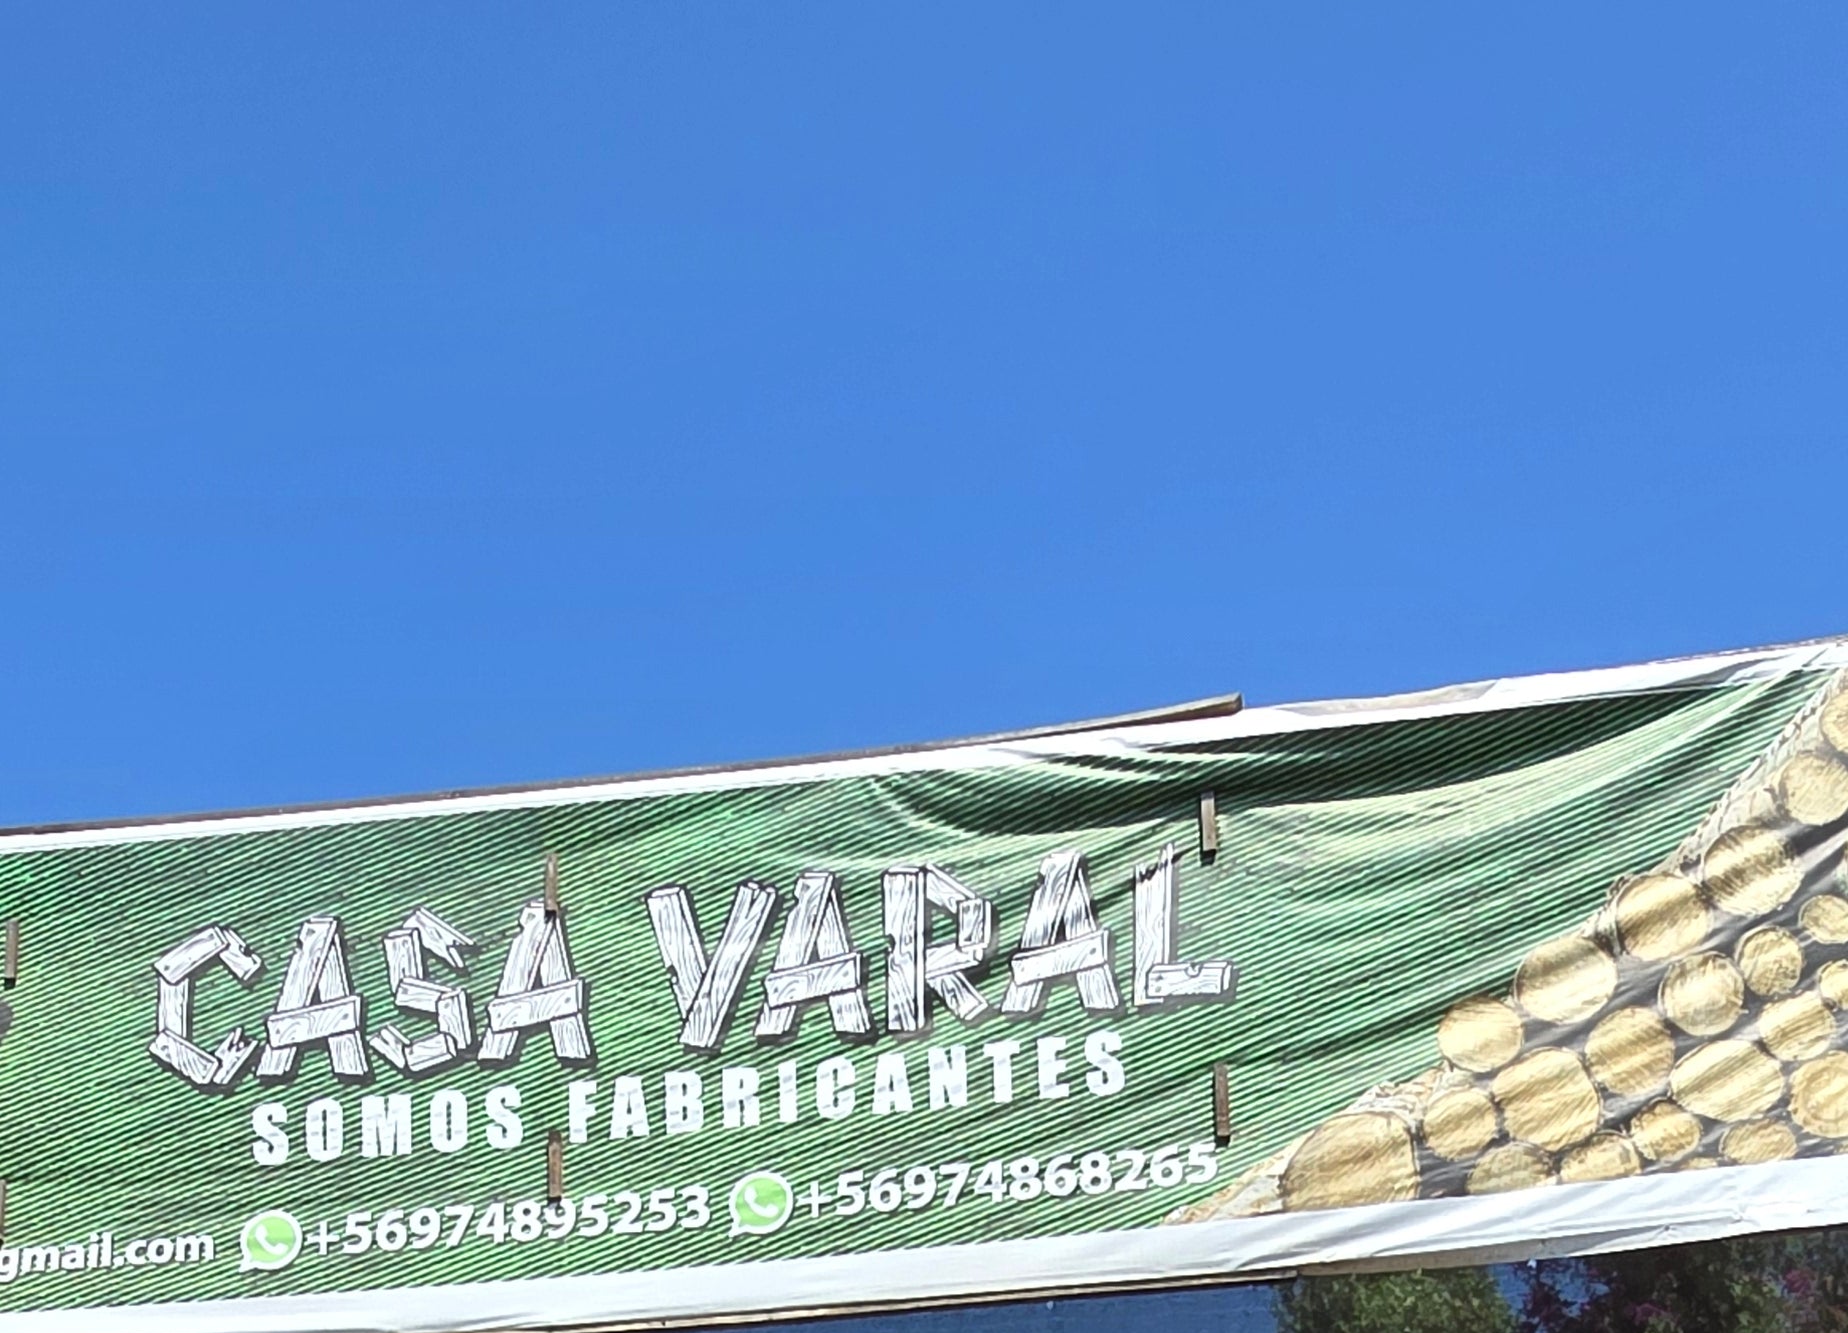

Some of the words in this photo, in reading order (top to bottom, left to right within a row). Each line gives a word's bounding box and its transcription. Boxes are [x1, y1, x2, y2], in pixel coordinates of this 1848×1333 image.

[148, 901, 594, 1085] CASA
[646, 843, 1236, 1050] VARAL
[251, 1083, 525, 1166] SOMOS
[567, 1029, 1127, 1142] FABRICANTES
[305, 1186, 712, 1258] +56974895253
[795, 1142, 1219, 1222] +56974868265
